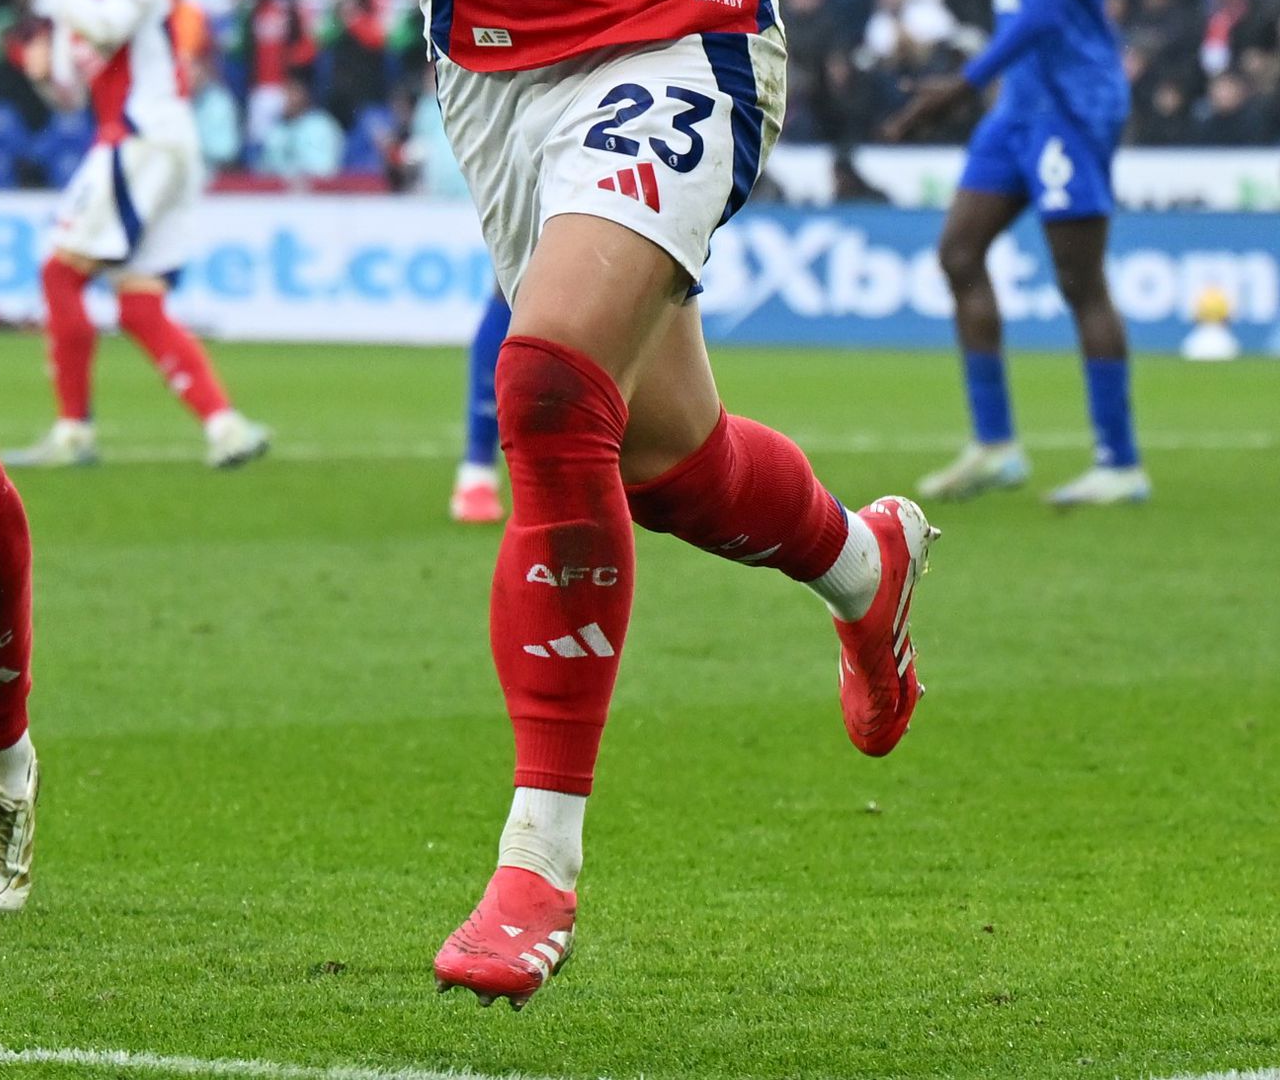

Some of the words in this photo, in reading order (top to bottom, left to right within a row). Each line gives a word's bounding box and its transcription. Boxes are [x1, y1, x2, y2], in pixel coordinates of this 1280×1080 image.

[583, 83, 716, 174] 23
[1037, 134, 1074, 188] 6
[526, 563, 618, 587] AFC
